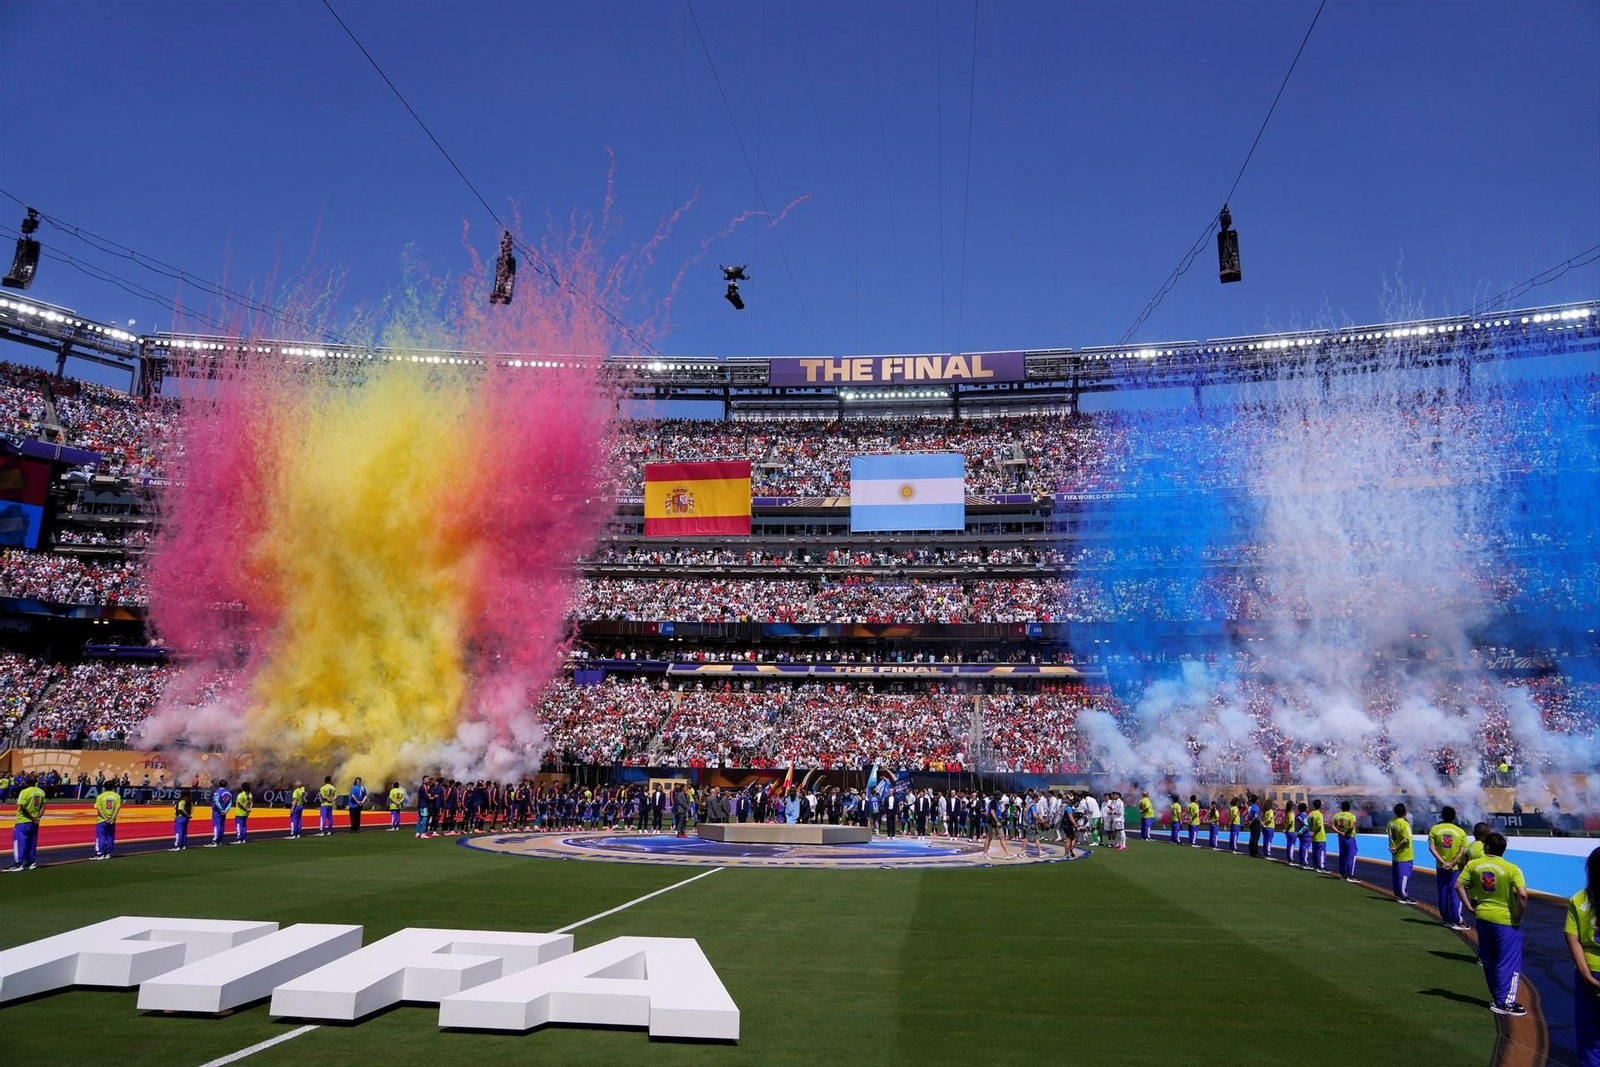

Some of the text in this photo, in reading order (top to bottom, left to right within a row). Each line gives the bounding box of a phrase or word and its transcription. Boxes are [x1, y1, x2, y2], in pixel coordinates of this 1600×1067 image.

[800, 355, 994, 382] THE FINAL
[878, 666, 943, 674] FINAL
[144, 760, 169, 769] FIFA
[263, 790, 308, 802] QATR
[0, 916, 740, 1040] FIFA
